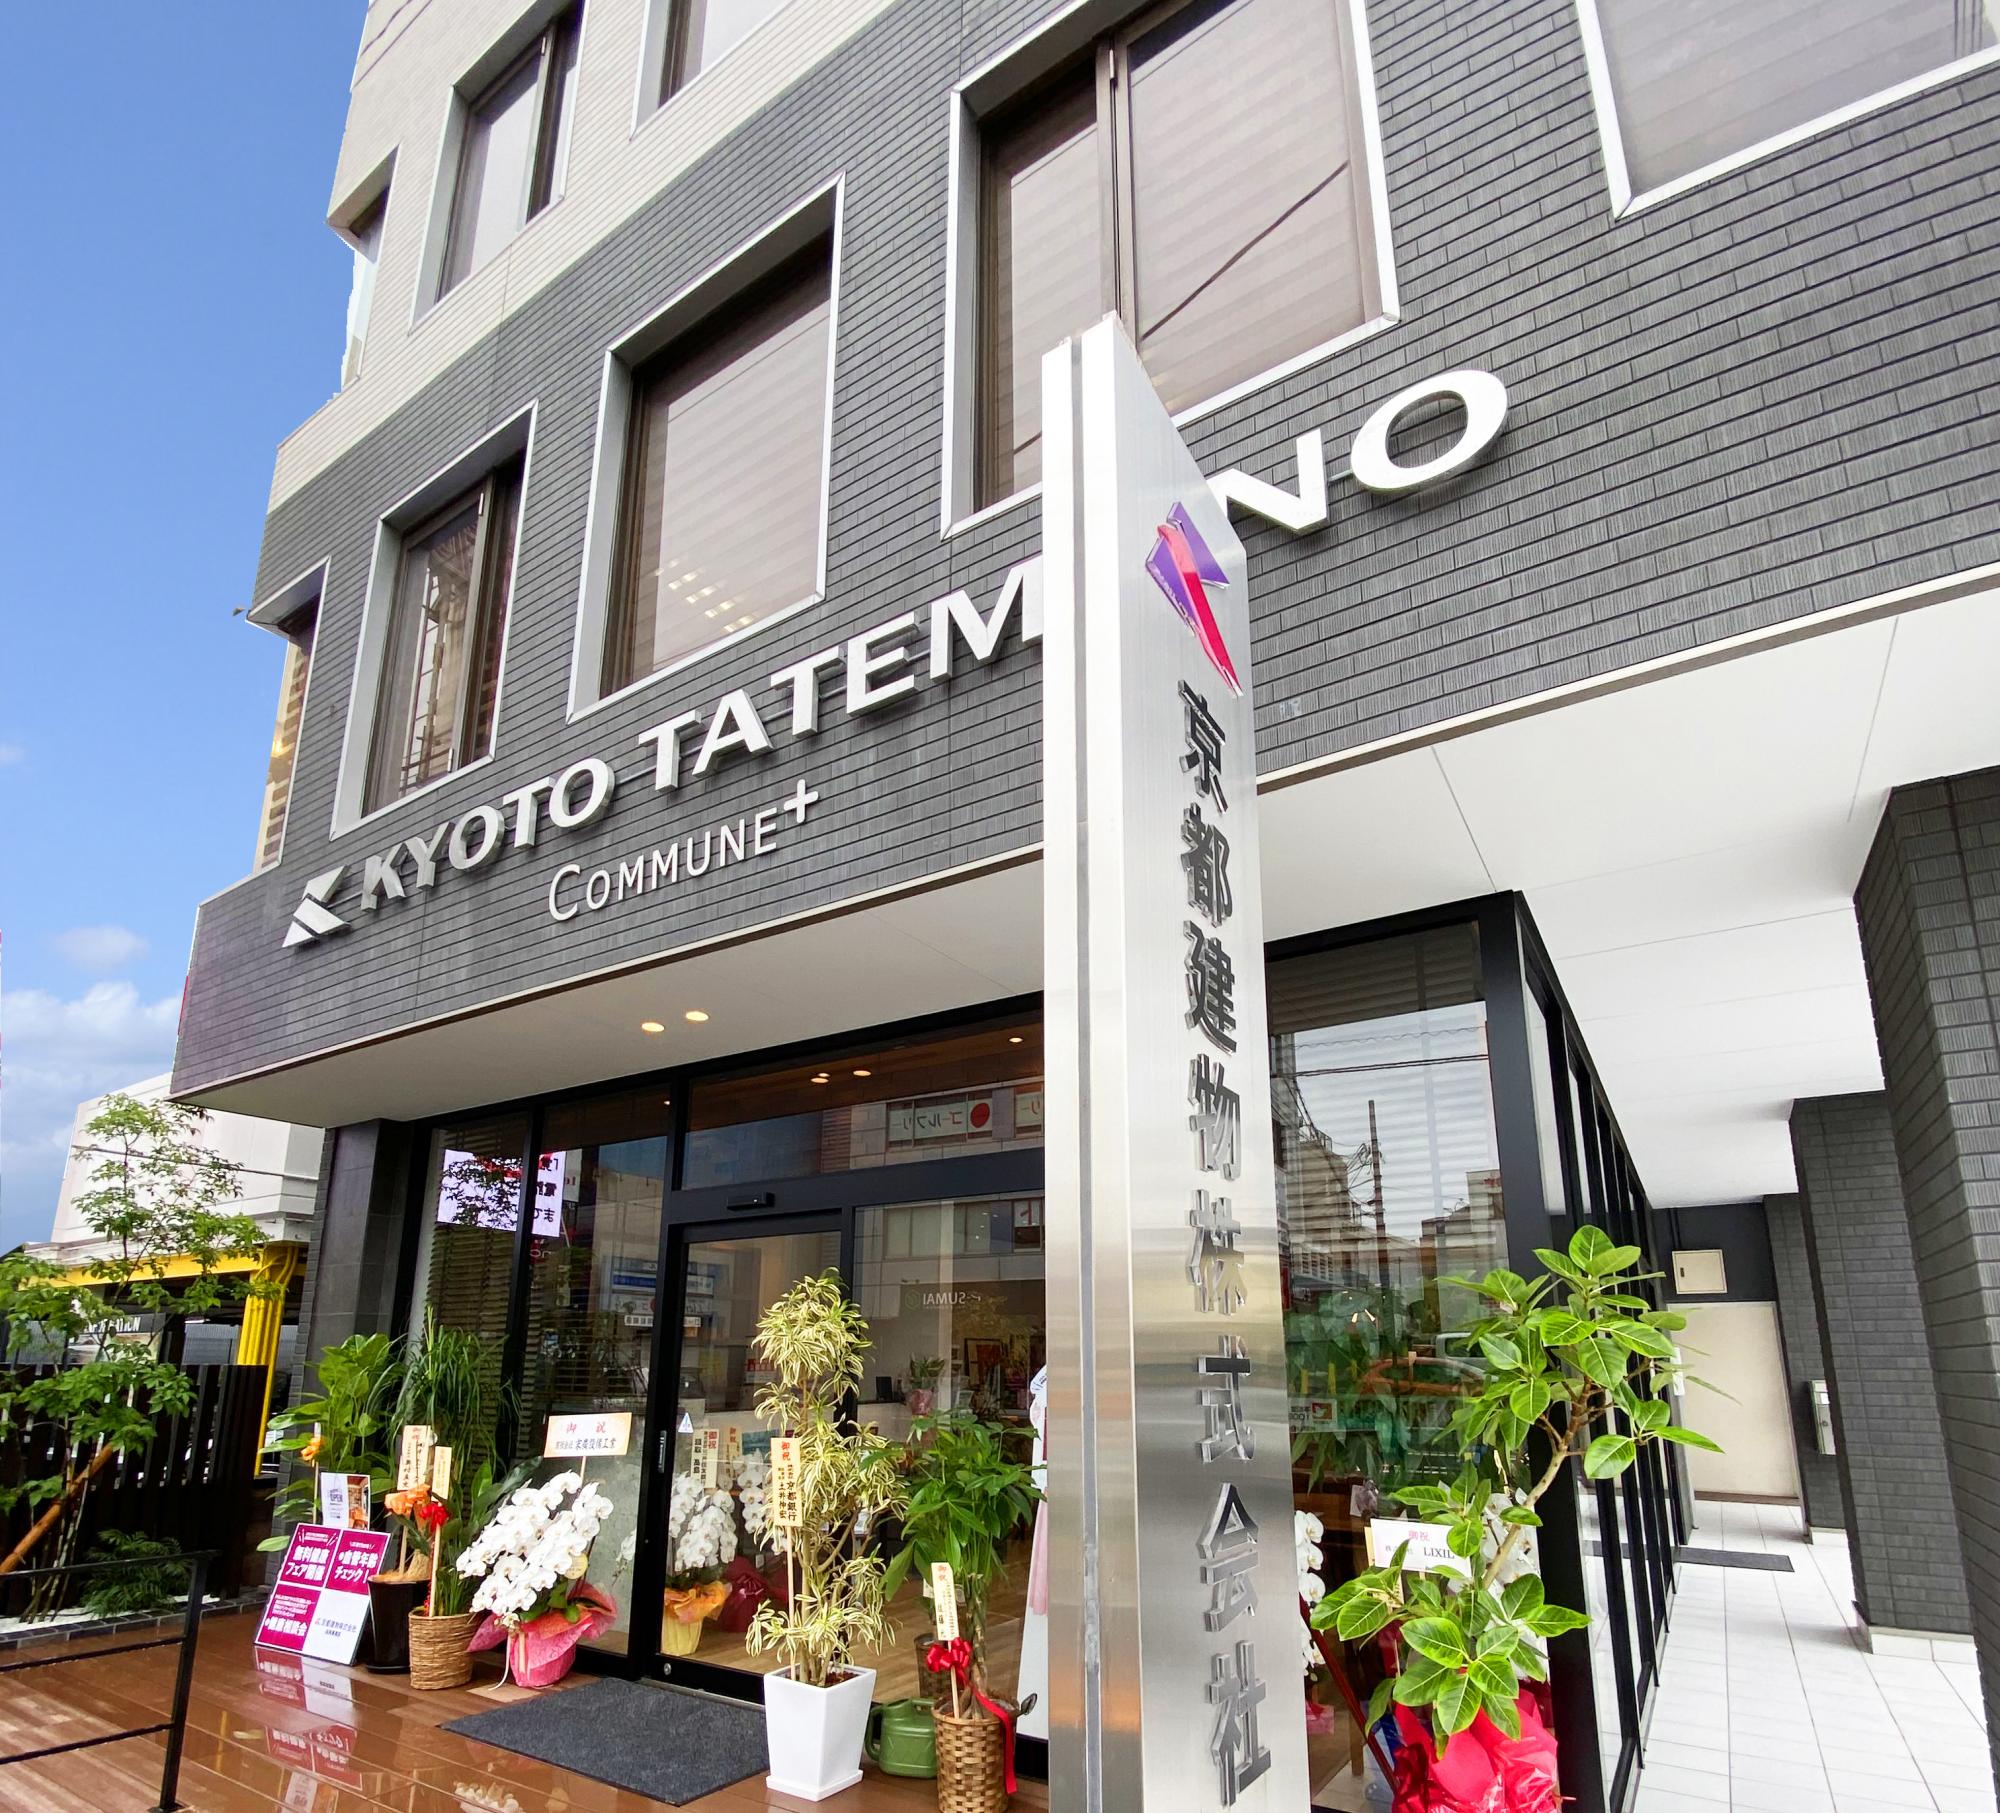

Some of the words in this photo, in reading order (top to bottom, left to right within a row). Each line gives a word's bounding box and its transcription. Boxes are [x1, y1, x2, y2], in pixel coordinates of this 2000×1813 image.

[360, 757, 615, 912] KYOTO
[639, 369, 1508, 793] TATEMNO
[1177, 679, 1271, 1808] 京都建物株式会社
[708, 1431, 718, 1449] 御祝
[786, 1480, 798, 1522] 京都銀行
[1423, 1546, 1455, 1559] LIXIL
